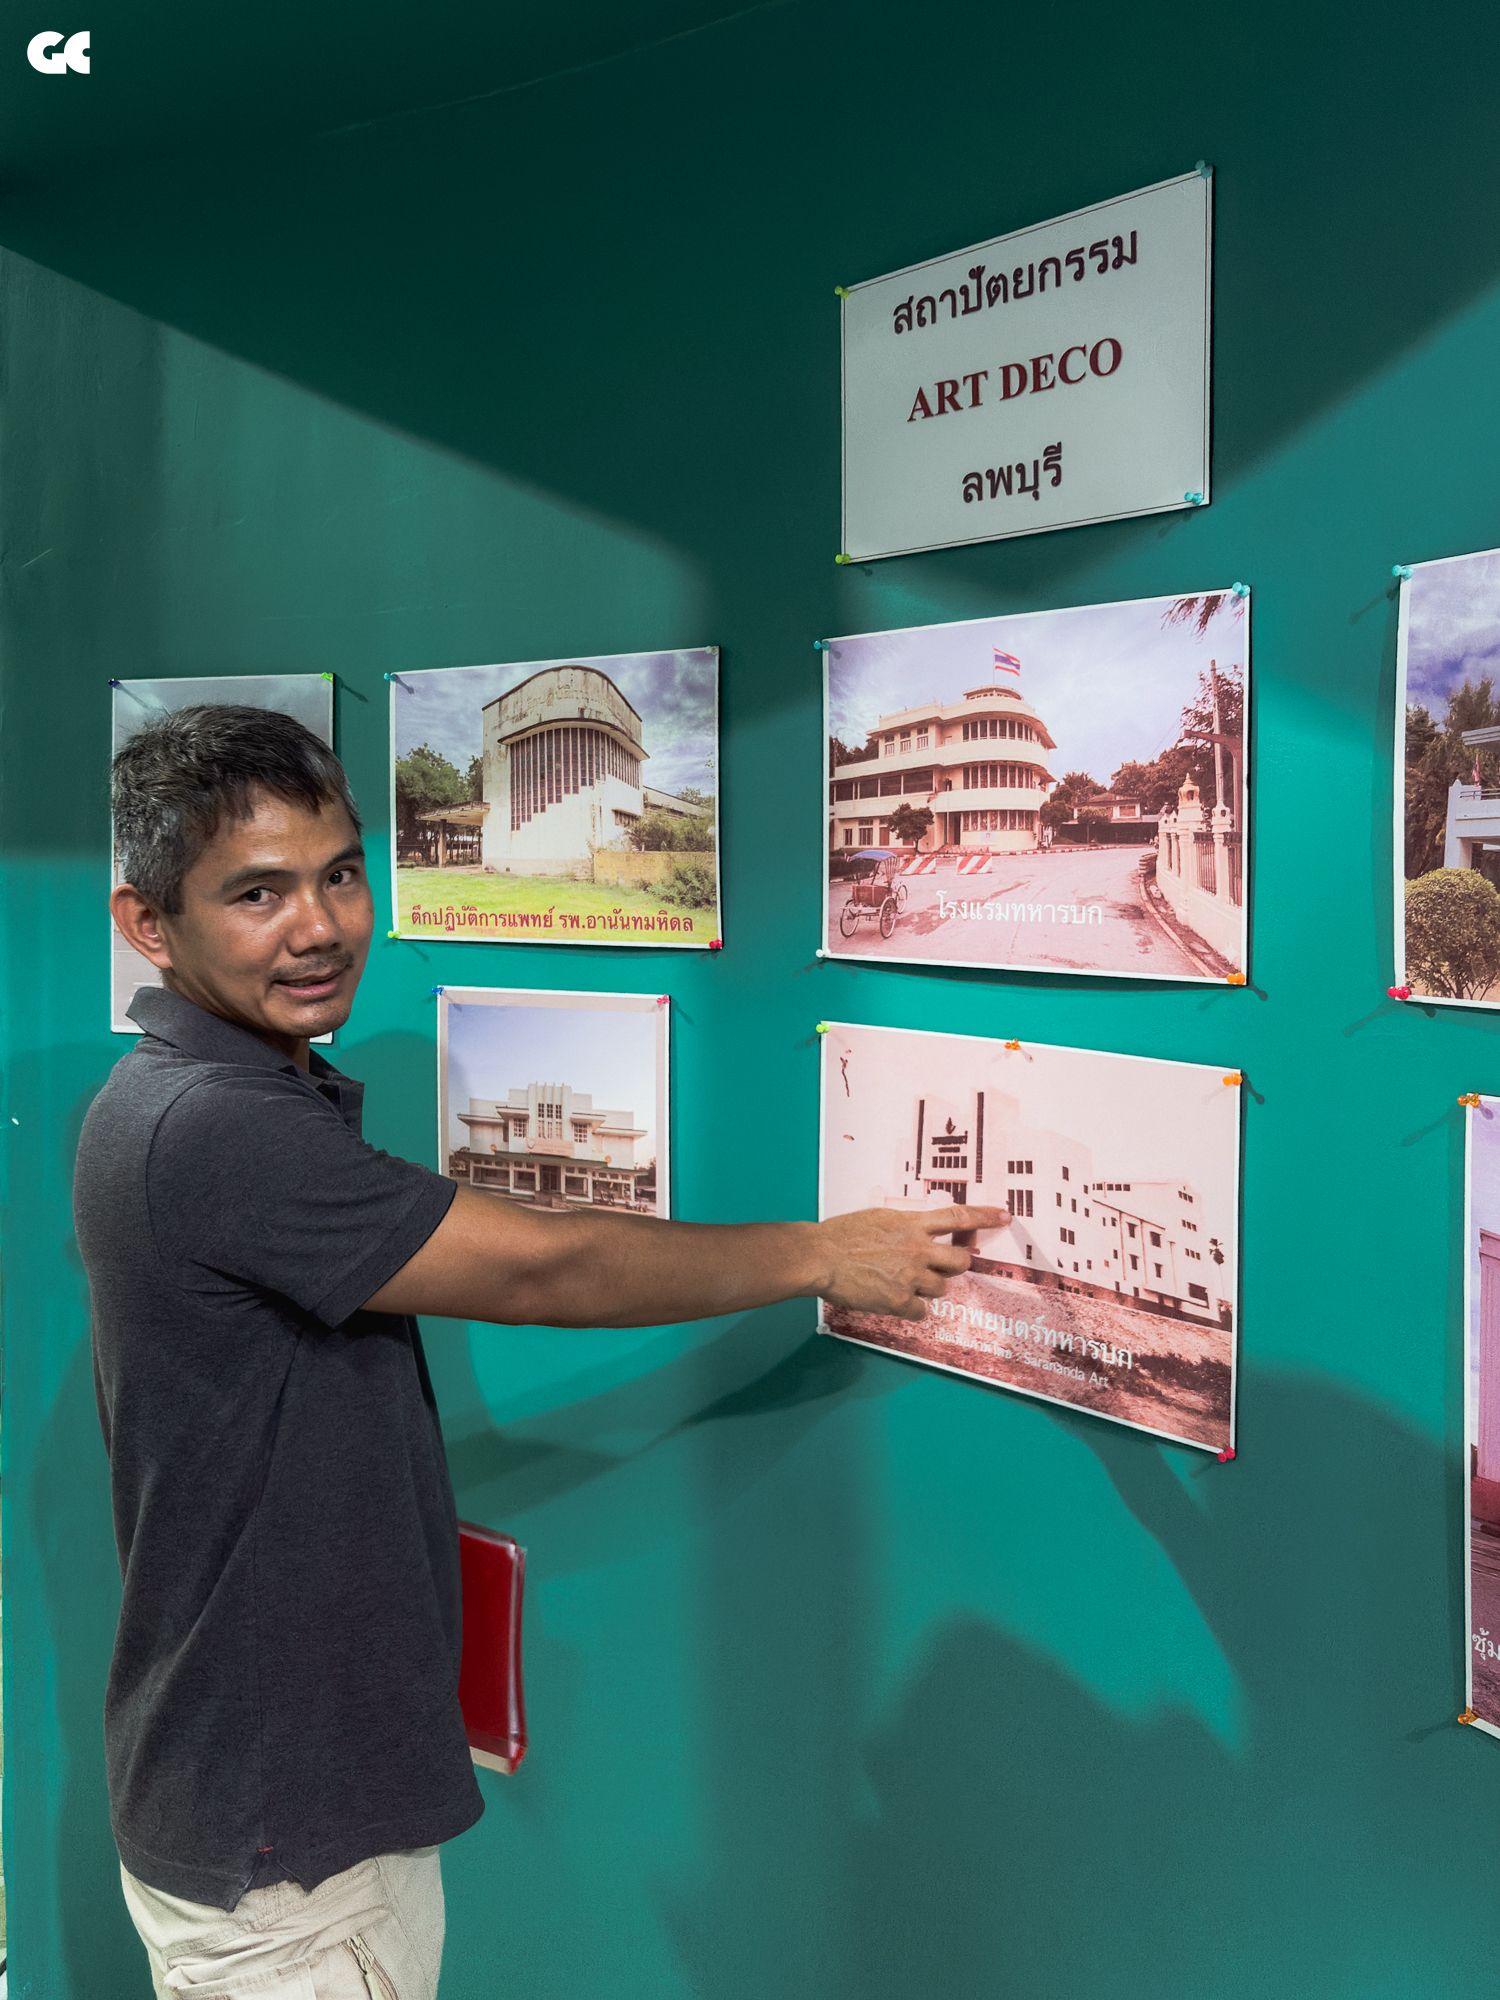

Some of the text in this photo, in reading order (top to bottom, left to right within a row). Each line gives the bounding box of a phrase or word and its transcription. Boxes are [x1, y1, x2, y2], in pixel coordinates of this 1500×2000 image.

[893, 230, 1138, 334] สถาปัตยกรรม
[907, 337, 1123, 422] ART DECO
[962, 441, 1063, 503] ลพบุรี
[411, 904, 694, 932] ตึกปฏิบัติการแพทย์ รพ.อานันทมหิดล
[935, 889, 1103, 925] โรงแรมทหารบก
[1088, 1371, 1110, 1389] Art
